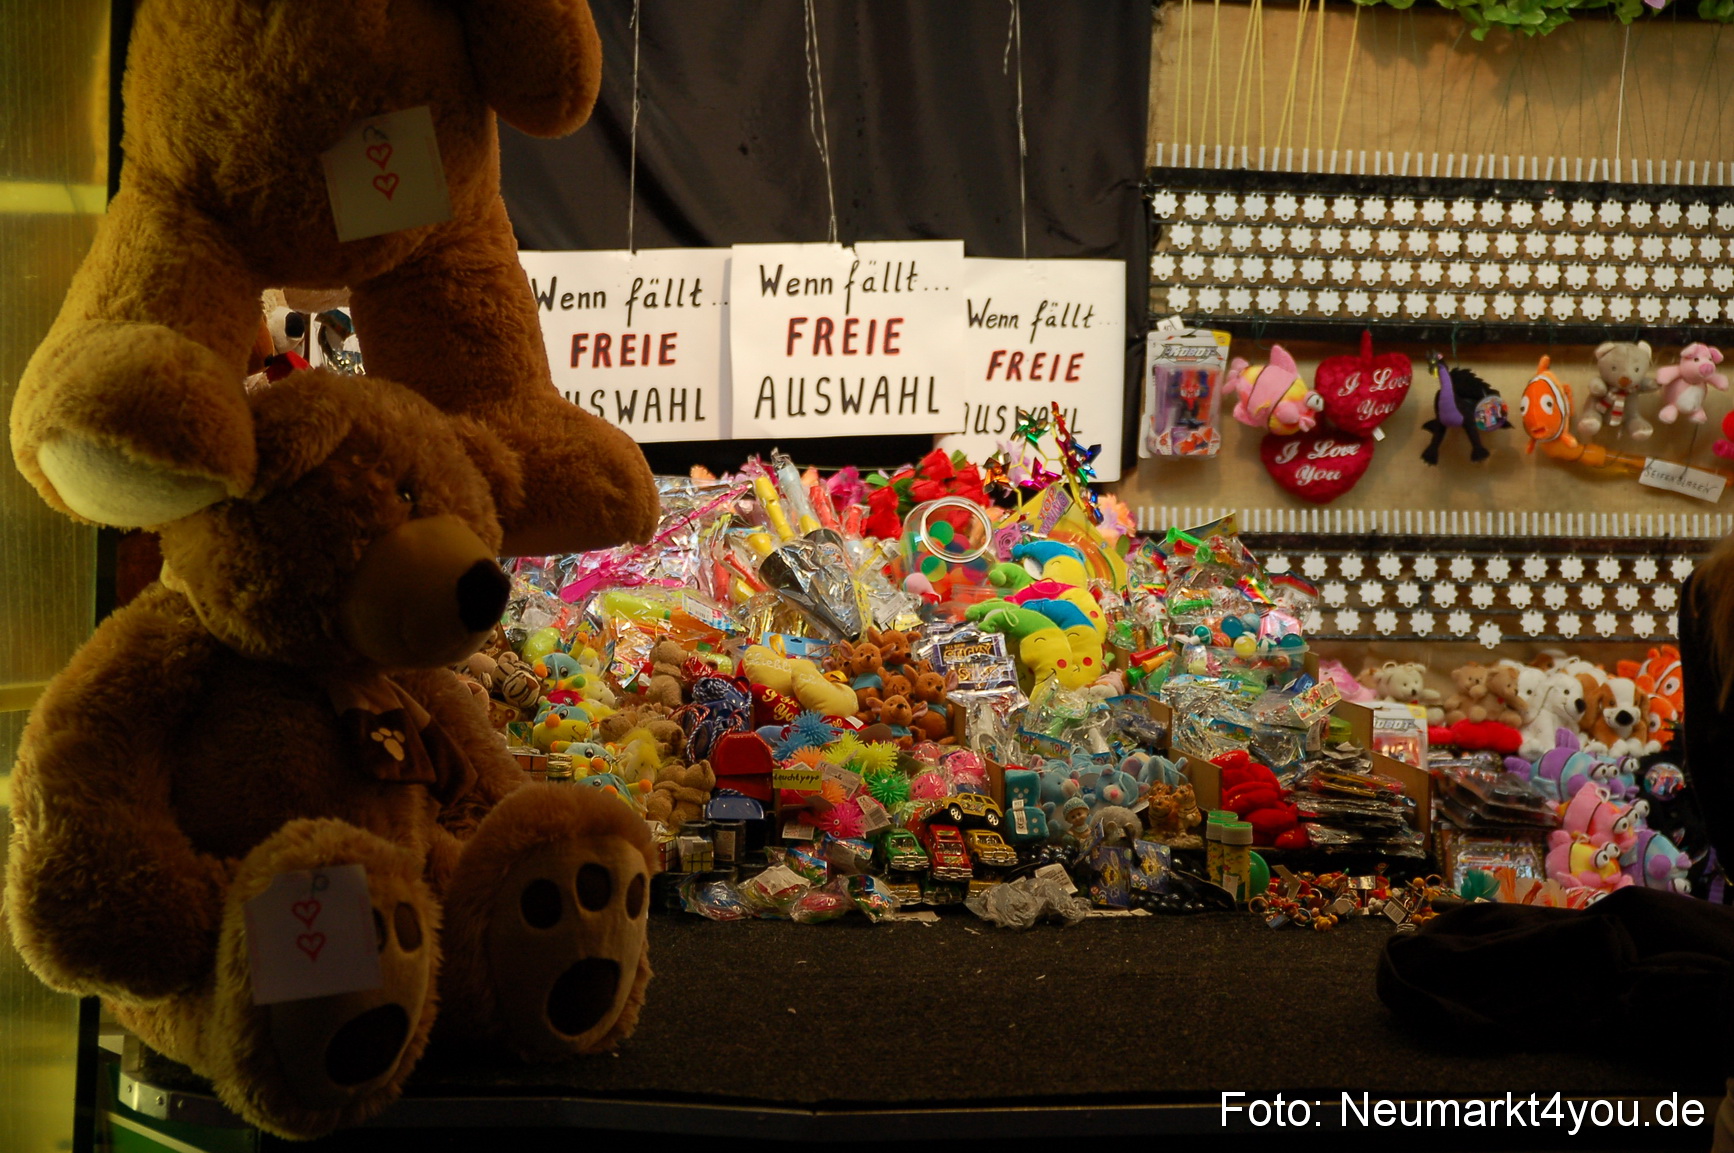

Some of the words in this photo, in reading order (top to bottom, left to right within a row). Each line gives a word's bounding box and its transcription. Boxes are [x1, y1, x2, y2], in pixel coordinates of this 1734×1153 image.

[531, 276, 607, 311] Wenn
[759, 263, 833, 298] Wenn
[967, 297, 1019, 329] Wenn
[570, 332, 678, 369] FREIE
[786, 316, 904, 357] FREIE
[985, 349, 1084, 383] FREIE
[754, 375, 940, 420] AUSWAHL
[1338, 371, 1361, 397] I
[1357, 399, 1397, 421] You
[1275, 441, 1300, 464] I
[1307, 440, 1361, 460] Love
[1295, 464, 1342, 486] You
